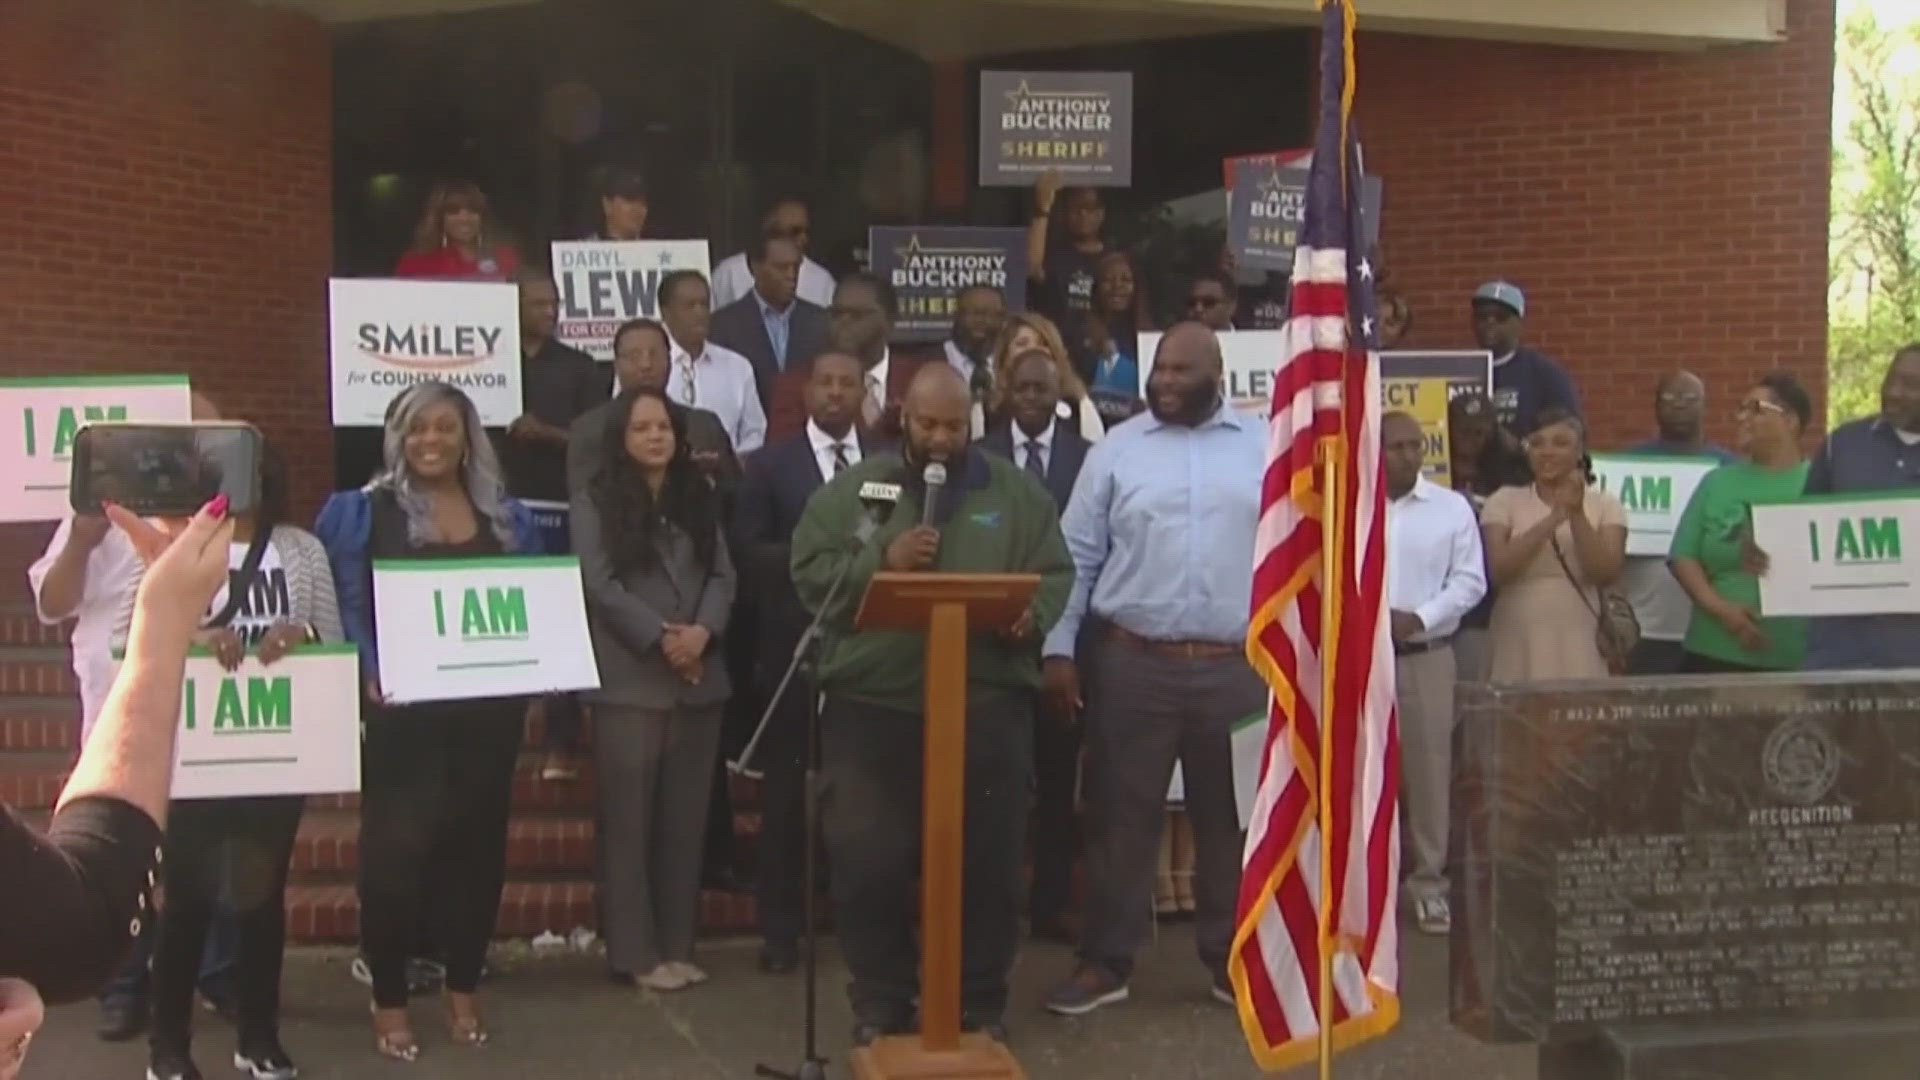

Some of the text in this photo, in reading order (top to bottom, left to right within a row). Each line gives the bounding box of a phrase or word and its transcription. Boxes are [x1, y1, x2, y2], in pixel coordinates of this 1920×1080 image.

[1018, 99, 1111, 114] ANTHONY
[1002, 114, 1112, 130] BUCKNER
[1001, 141, 1111, 158] SHERIFF
[560, 250, 625, 267] DARYL
[907, 255, 1006, 269] ANTHONY
[891, 269, 1007, 288] BUCKNER
[563, 270, 662, 318] LEW
[562, 323, 588, 336] FOR
[347, 369, 507, 388] for COUNTY MAYOR
[23, 407, 36, 456] I
[1619, 475, 1672, 510] AM
[1809, 516, 1902, 562] I AM
[433, 586, 529, 637] I AM
[185, 676, 292, 730] I AM
[1749, 805, 1853, 825] RECOGNITION
